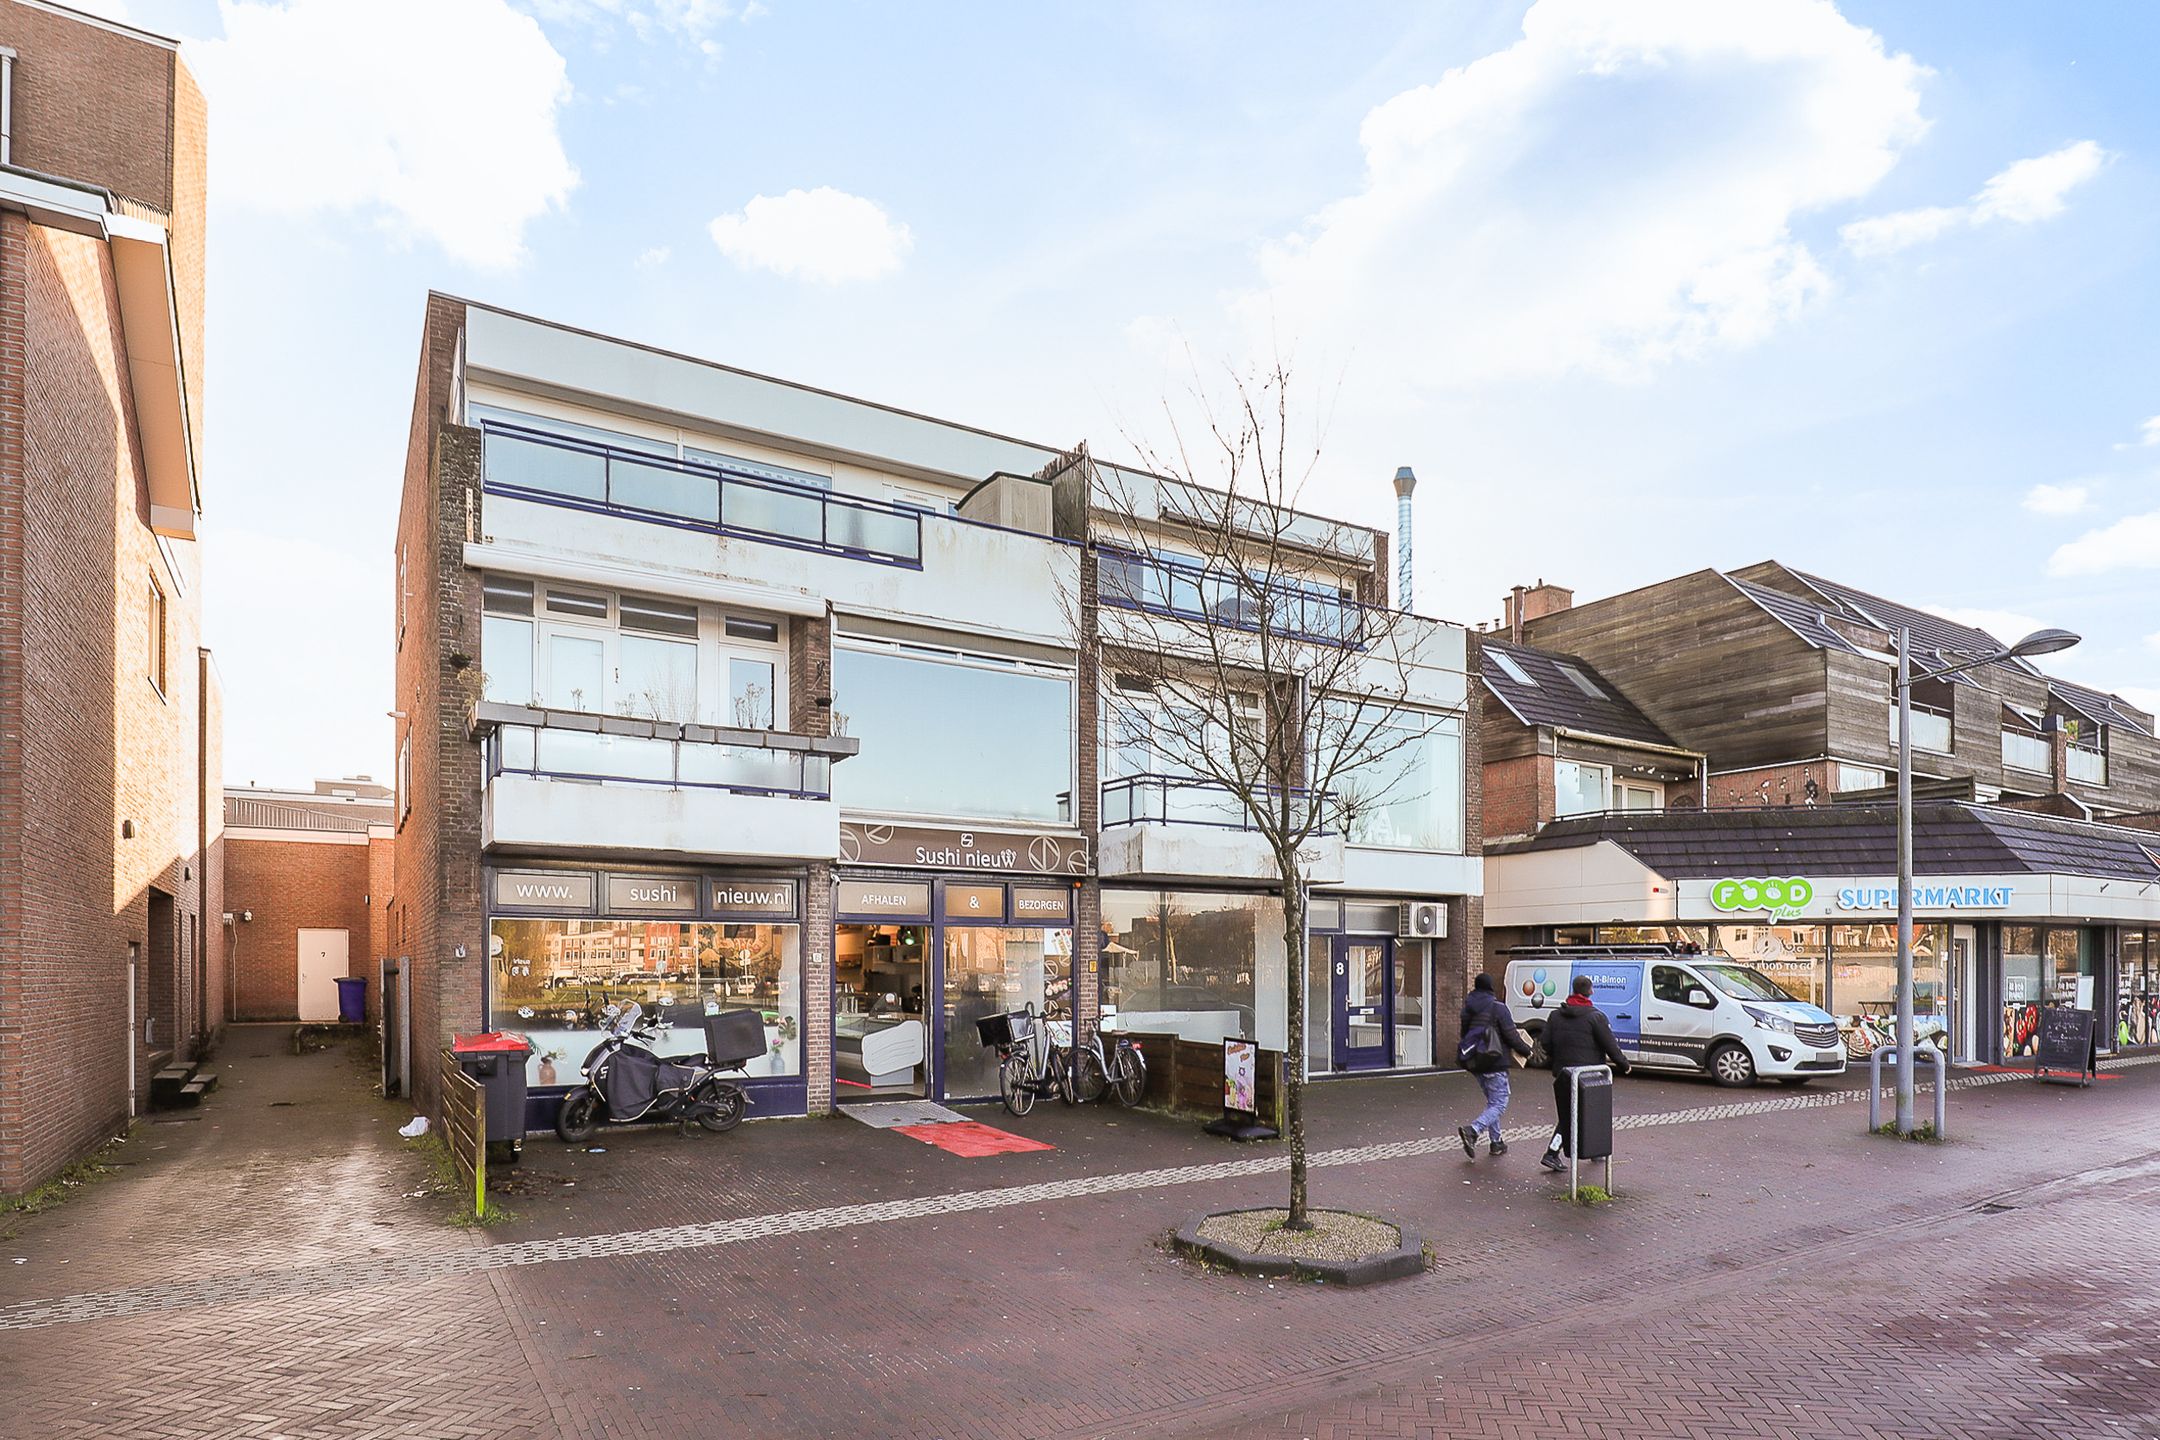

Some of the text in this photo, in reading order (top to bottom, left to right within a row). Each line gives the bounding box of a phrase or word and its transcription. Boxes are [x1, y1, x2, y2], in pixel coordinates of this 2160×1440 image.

[915, 847, 1017, 869] Sushi nieuw
[516, 883, 789, 905] www. sushi nieuw.nl
[1720, 881, 1807, 903] FOOD
[861, 894, 1064, 911] AFHALEN & BEZORGEN
[1772, 905, 1802, 923] plus
[1335, 962, 1345, 976] 8
